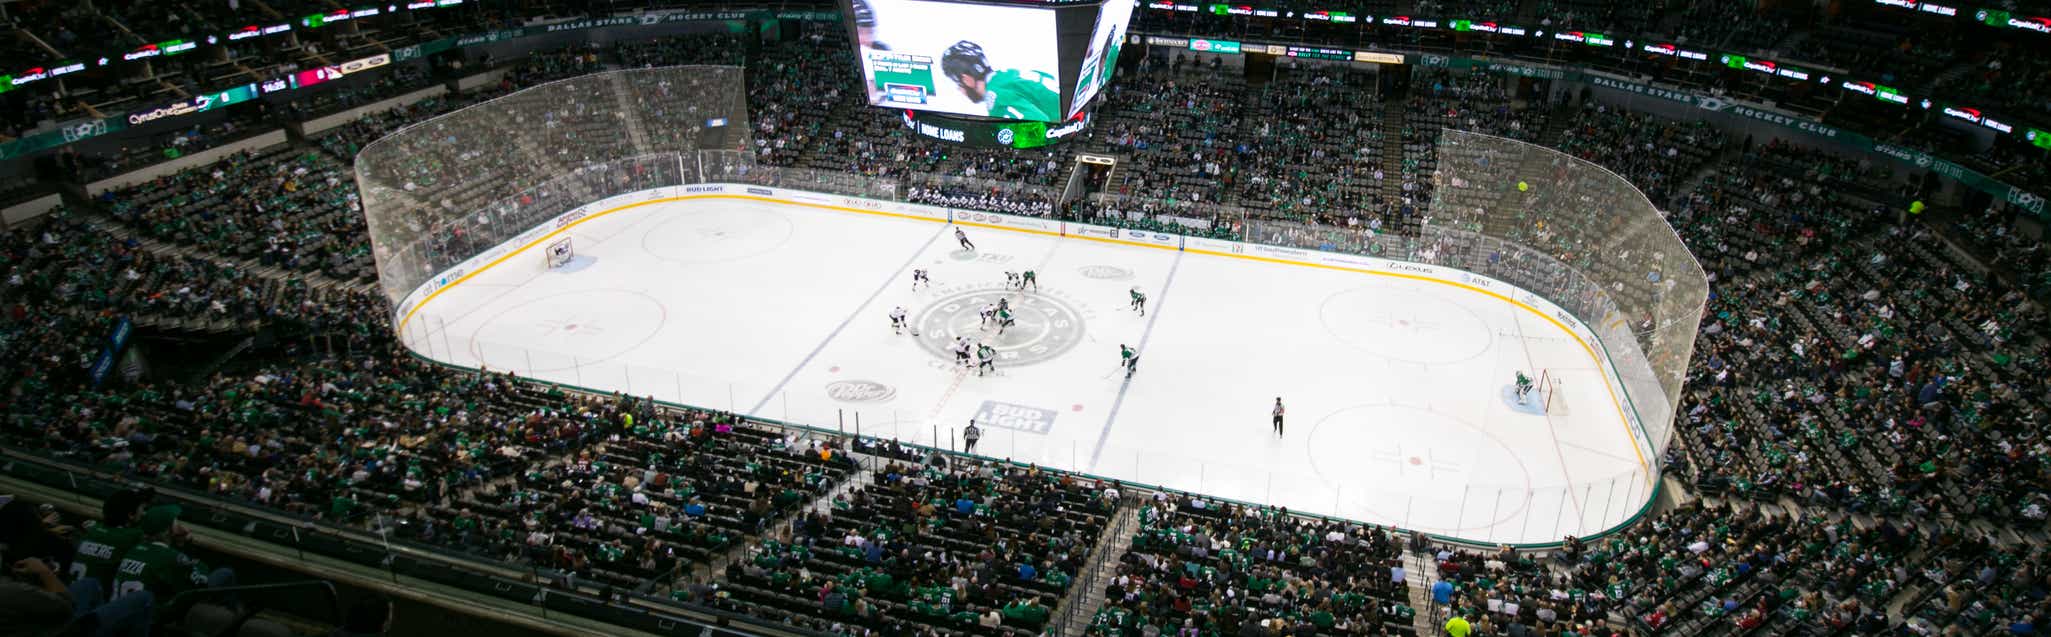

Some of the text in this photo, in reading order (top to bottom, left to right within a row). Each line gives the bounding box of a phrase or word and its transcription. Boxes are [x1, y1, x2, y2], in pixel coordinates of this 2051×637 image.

[1734, 105, 1837, 137] HOCKEY CLUB
[921, 123, 965, 142] HOME LOANS
[993, 402, 1043, 421] BUD
[977, 411, 1050, 433] LIGHT
